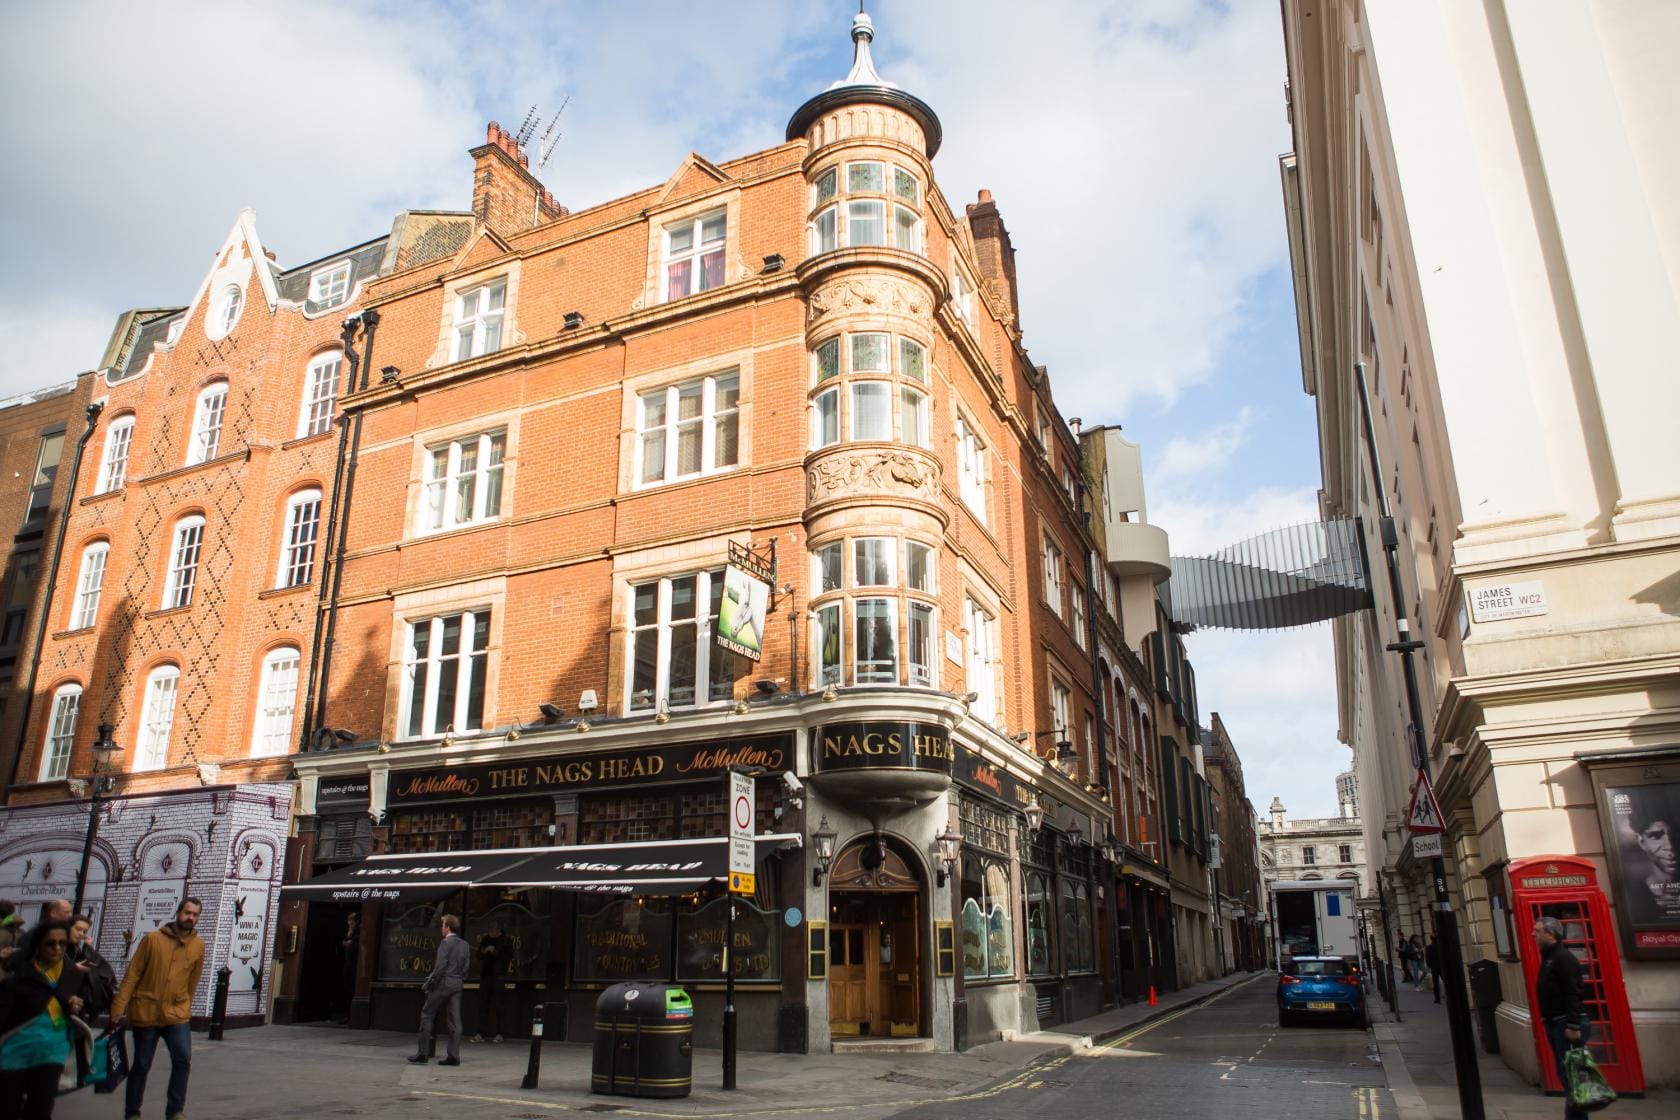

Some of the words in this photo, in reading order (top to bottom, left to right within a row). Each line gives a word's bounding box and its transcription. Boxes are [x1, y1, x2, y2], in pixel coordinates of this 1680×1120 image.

[1477, 587, 1511, 599] JAMES
[1478, 597, 1513, 609] STREET
[1519, 594, 1542, 604] WC2
[717, 635, 729, 649] THE
[729, 641, 745, 655] NAGS
[745, 646, 761, 661] HEAD
[824, 733, 901, 758] NAGS
[676, 746, 784, 773] McMullen
[489, 767, 528, 788] THE
[536, 761, 592, 785] NAGS
[600, 755, 664, 779] HEAD
[321, 785, 341, 796] upstairs
[348, 784, 356, 793] the
[357, 784, 369, 794] nags
[396, 774, 480, 797] McMullen
[736, 783, 751, 795] ZONE
[1415, 840, 1440, 853] School
[1524, 876, 1586, 888] TELEPHONE
[332, 890, 359, 898] upstairs
[361, 888, 370, 897] @
[371, 889, 382, 897] the
[383, 890, 400, 899] nags
[240, 921, 253, 929] WIN!
[255, 921, 259, 929] A
[1642, 935, 1666, 944] Royal
[240, 944, 252, 952] KEY
